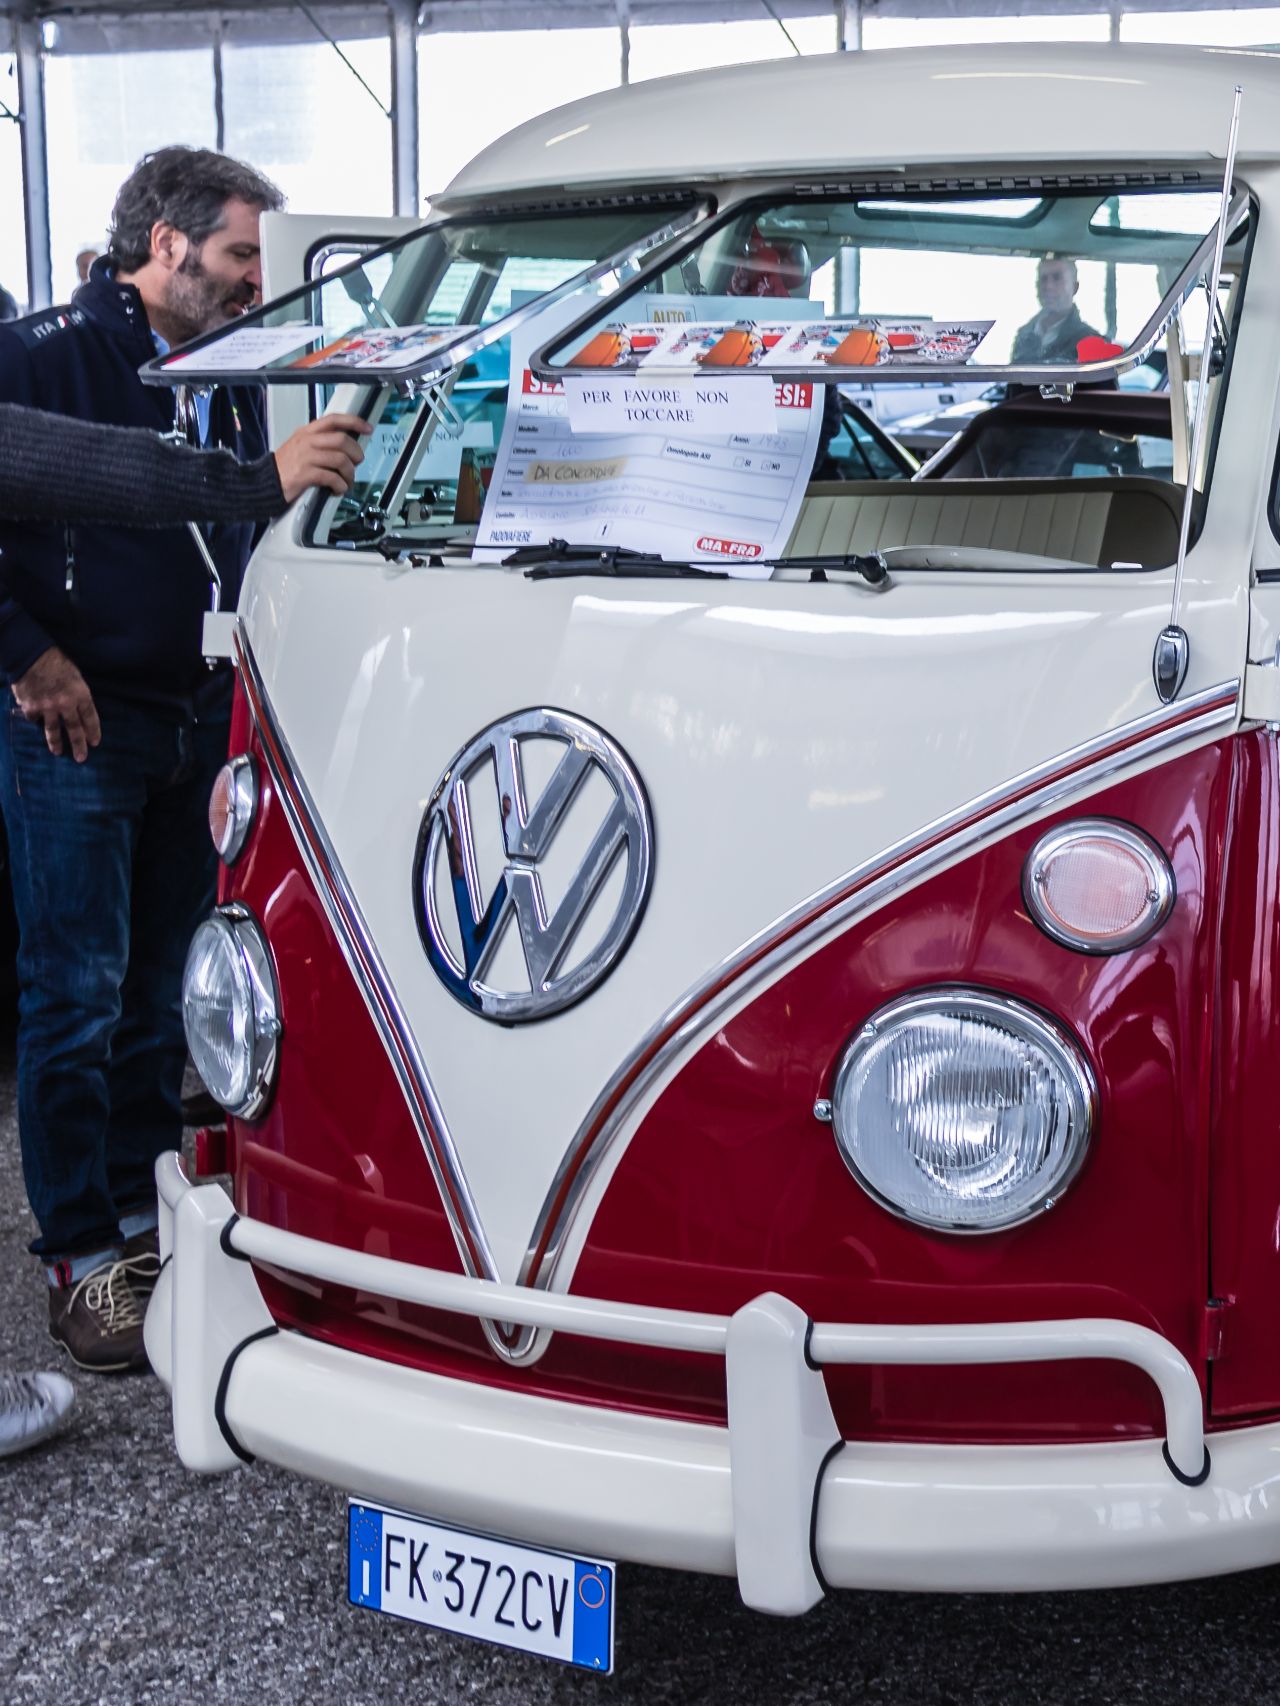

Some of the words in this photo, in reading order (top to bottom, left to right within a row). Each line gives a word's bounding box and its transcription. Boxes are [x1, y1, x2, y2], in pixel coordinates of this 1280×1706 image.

[582, 391, 612, 404] PER
[624, 389, 681, 404] FAVORE
[696, 391, 729, 404] NON
[624, 407, 695, 423] TOCCARE
